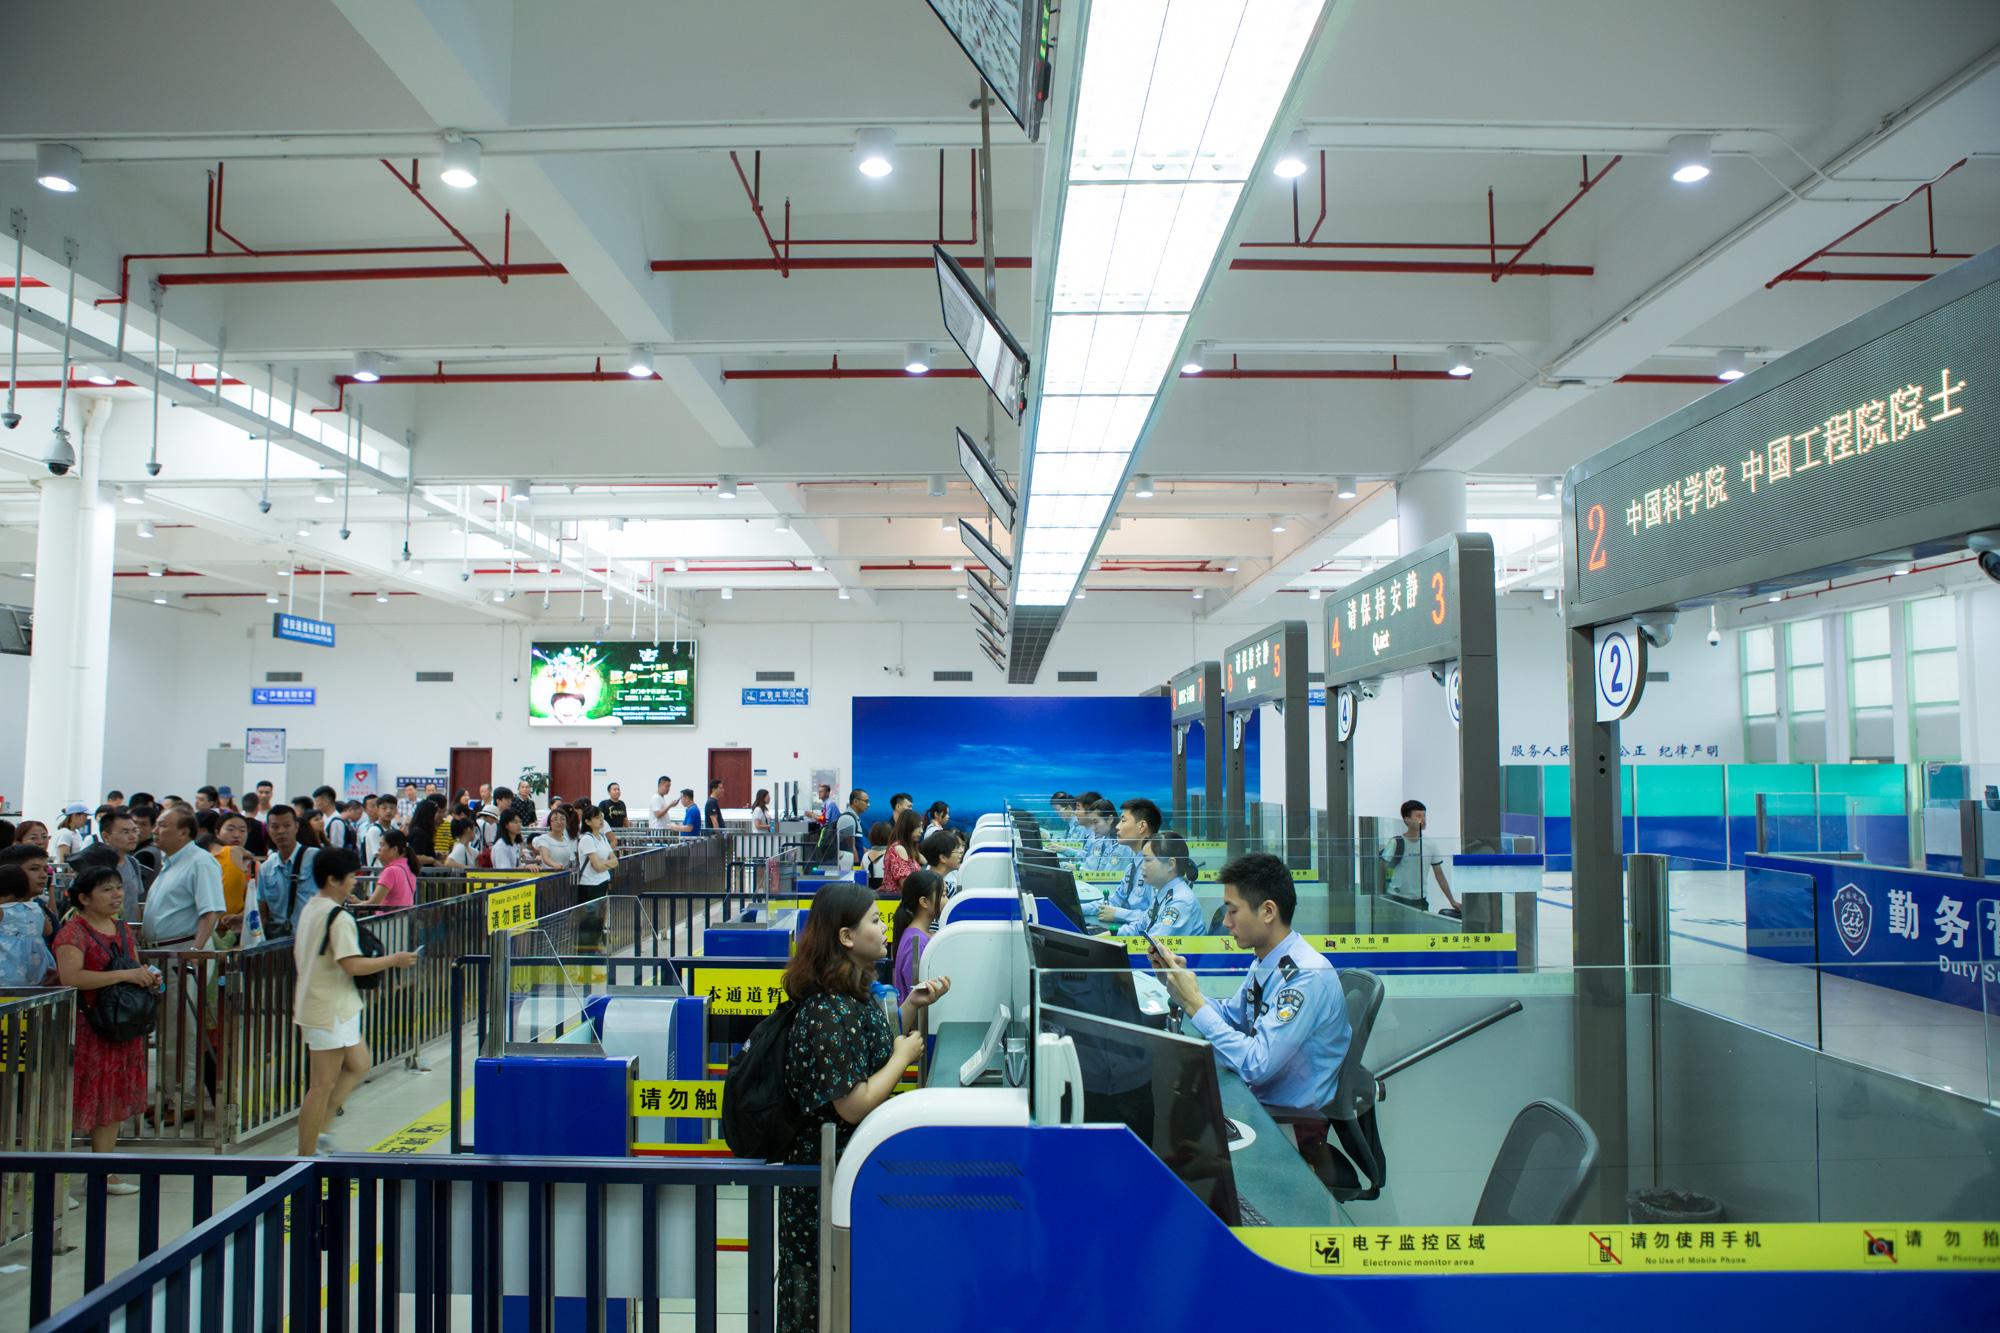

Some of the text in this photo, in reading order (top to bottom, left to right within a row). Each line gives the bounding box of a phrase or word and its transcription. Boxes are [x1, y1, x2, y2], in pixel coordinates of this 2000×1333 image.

[1626, 368, 1967, 536] 中国科学院 中国工程院院士
[1587, 503, 1607, 571] 2
[1331, 570, 1446, 657] 4 请保持安静 3
[1372, 629, 1390, 656] Quiet
[1273, 643, 1281, 678] 5
[1610, 645, 1623, 693] 2
[1342, 699, 1348, 726] 4
[1659, 744, 1719, 758] 纪律严明
[491, 902, 532, 929] 请勿翻越
[1132, 938, 1183, 946] 电子区域
[1441, 935, 1491, 944] 请保持安静
[1939, 954, 2000, 983] Duty S
[705, 986, 783, 1003] 本通道暂
[707, 1007, 741, 1015] LOSED
[640, 1087, 718, 1111] 请勿触
[1353, 1234, 1486, 1251] 电子监控区域
[1630, 1231, 1762, 1249] 请勿使用手机
[1905, 1230, 2000, 1248] 请勿拍
[1363, 1258, 1412, 1267] Electronic
[1414, 1258, 1451, 1267] monitor
[1645, 1256, 1746, 1265] No Use of Mobile Phone
